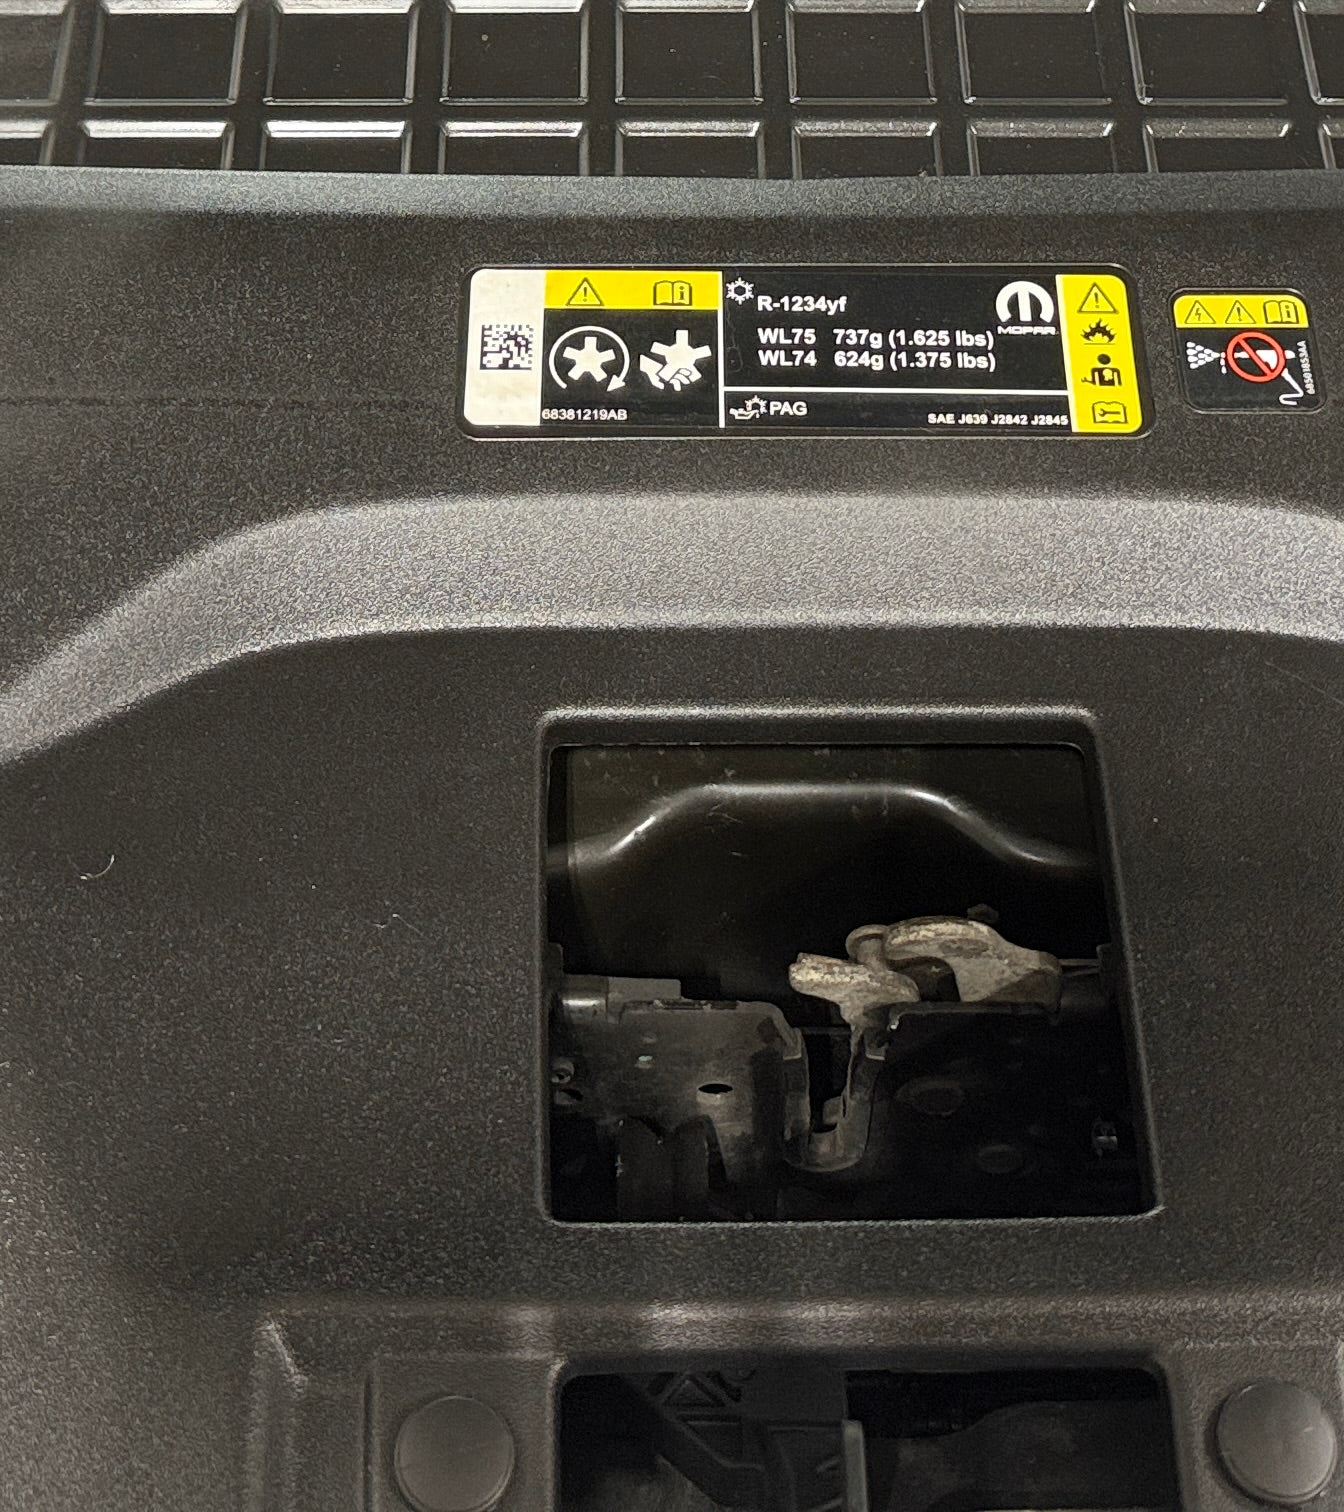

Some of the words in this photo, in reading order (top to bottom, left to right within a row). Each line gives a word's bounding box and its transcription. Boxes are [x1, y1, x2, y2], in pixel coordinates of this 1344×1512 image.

[757, 295, 848, 316] R-1234yf
[757, 327, 817, 345] WL75
[832, 328, 883, 349] 737g
[888, 329, 951, 349] (1.625
[955, 329, 995, 350] lbs)
[997, 325, 1057, 336] MOPAR
[757, 349, 818, 367] WL74
[833, 350, 884, 371] 624g
[889, 351, 952, 371] (1.375
[956, 352, 996, 372] lbs)
[541, 408, 628, 421] 68381219AB
[769, 400, 808, 417] PAG
[927, 413, 956, 425] SAE
[957, 413, 989, 425] J639
[990, 413, 1029, 426] J2842
[1030, 414, 1069, 426] J2845
